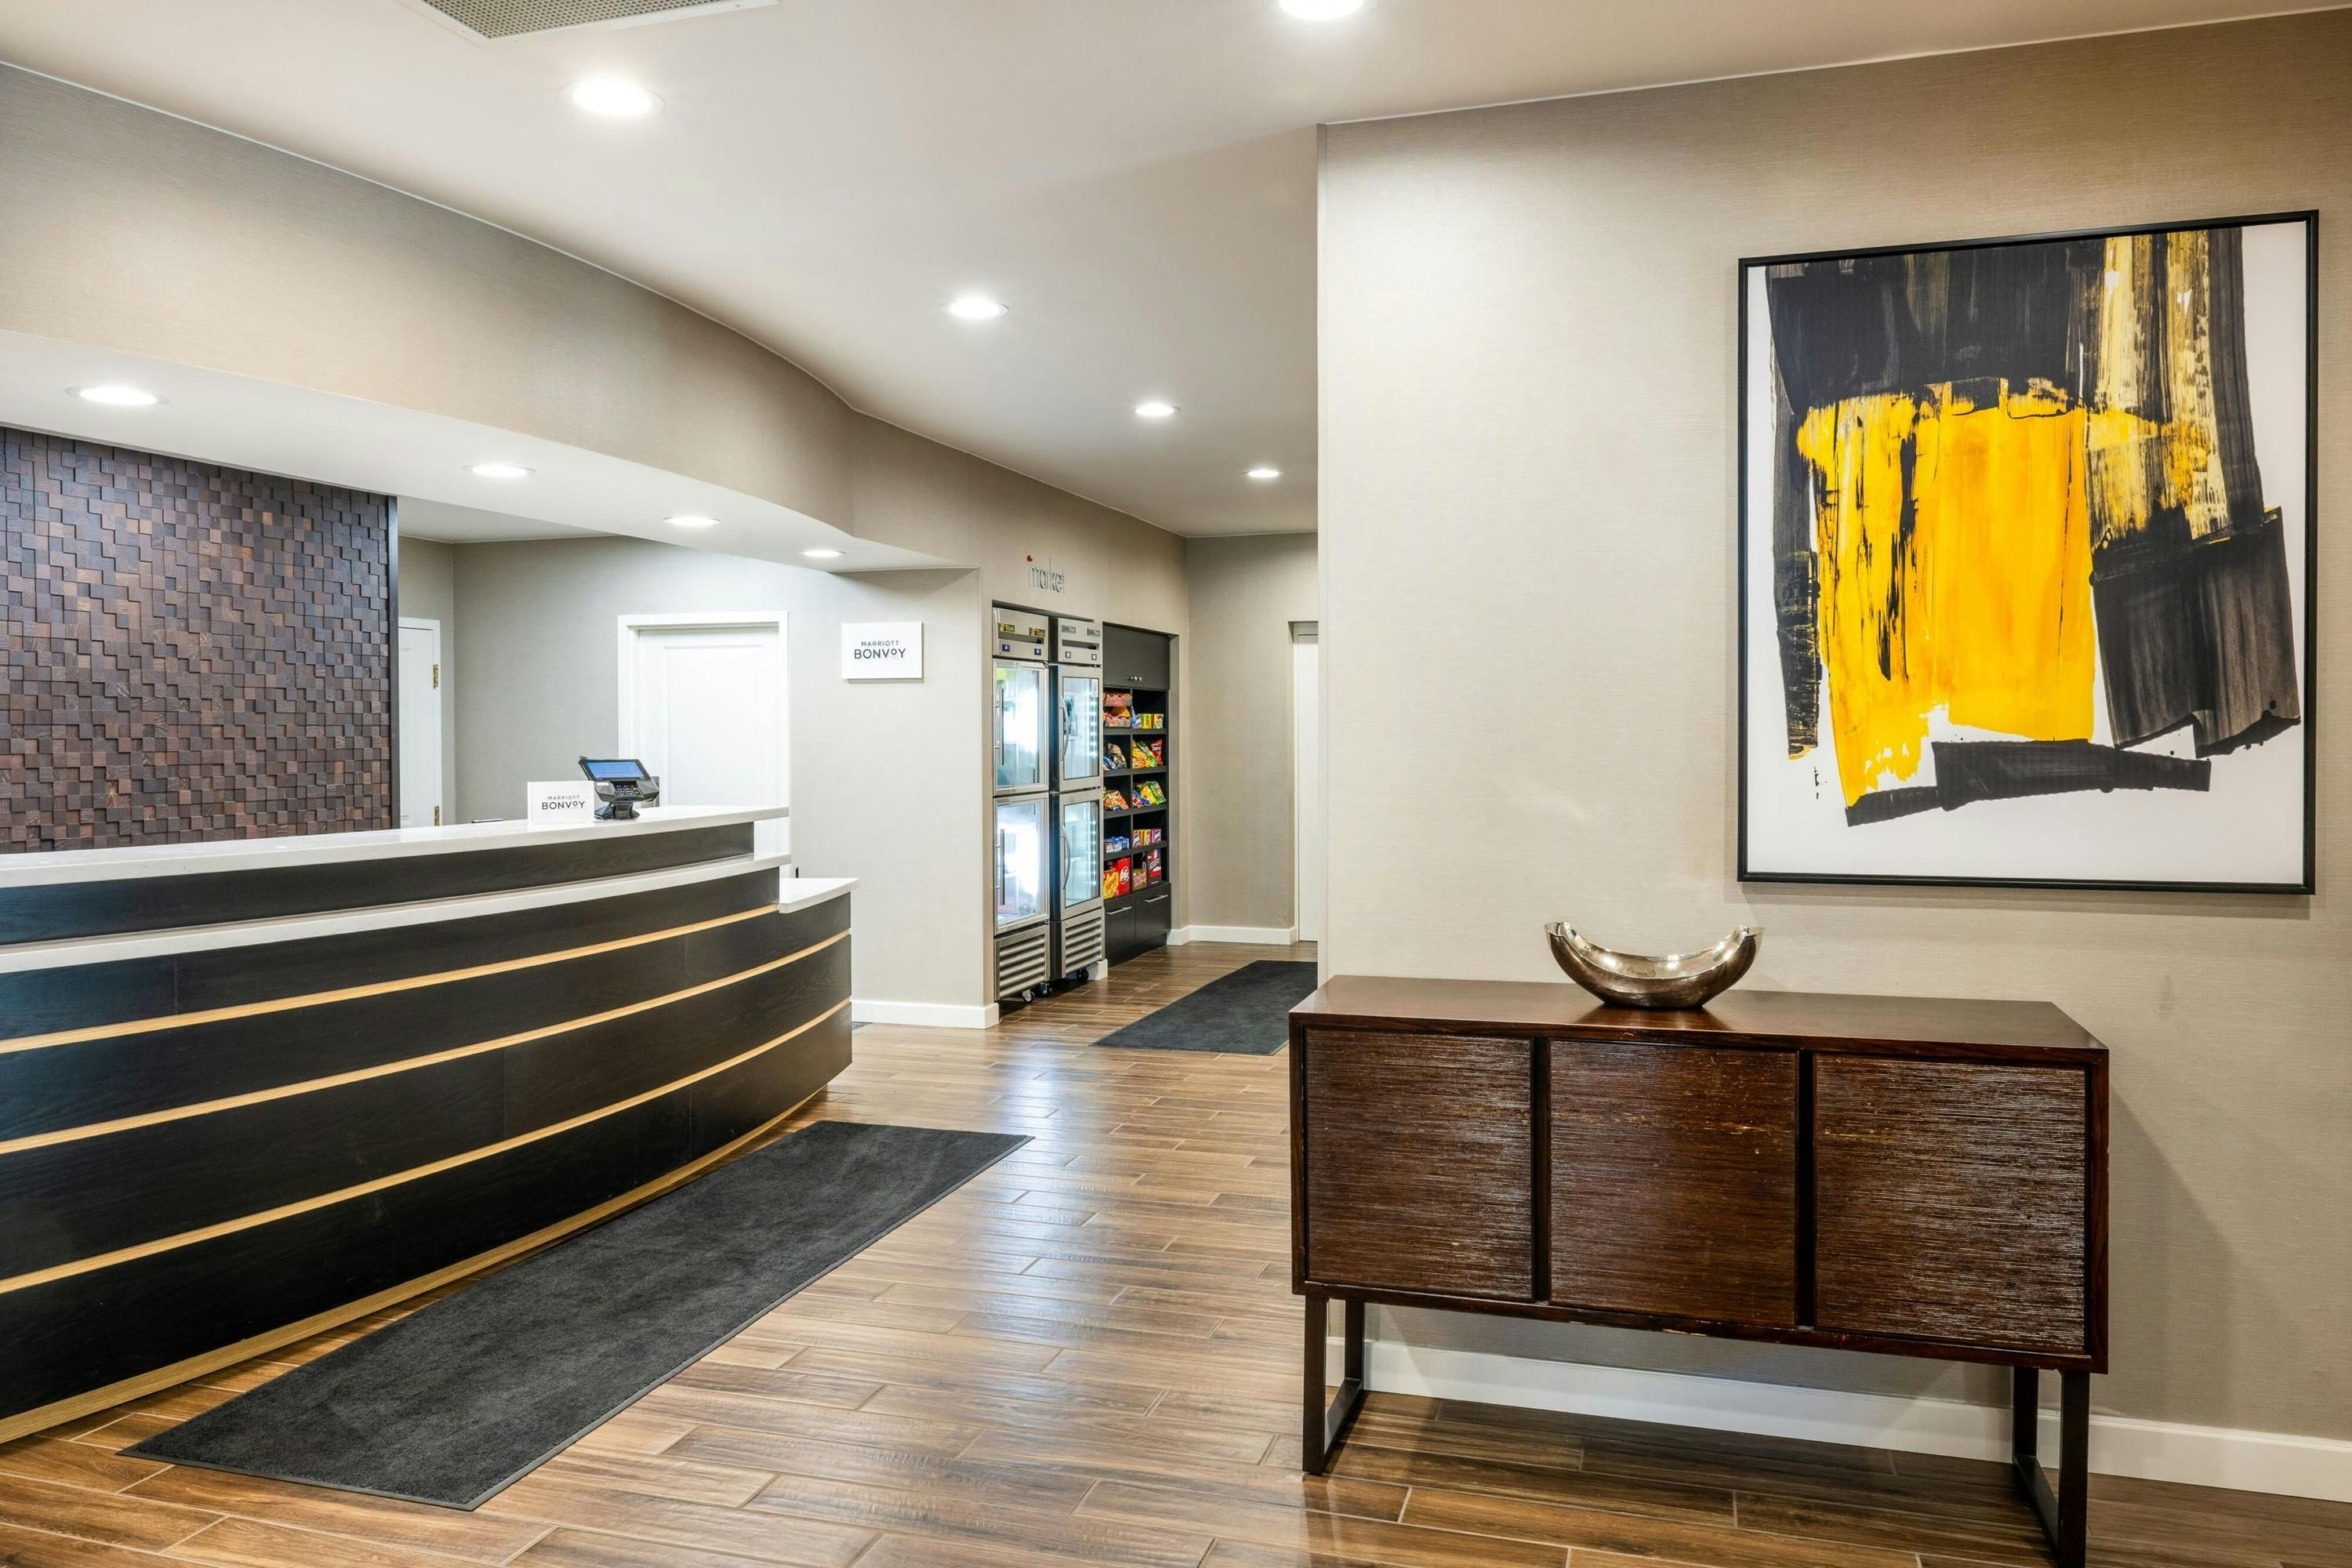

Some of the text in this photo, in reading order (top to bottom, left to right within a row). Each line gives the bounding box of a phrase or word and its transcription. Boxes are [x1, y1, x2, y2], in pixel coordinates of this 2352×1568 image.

[1028, 557, 1066, 593] market
[854, 648, 906, 659] BONVOY
[542, 800, 586, 810] BONVOY
